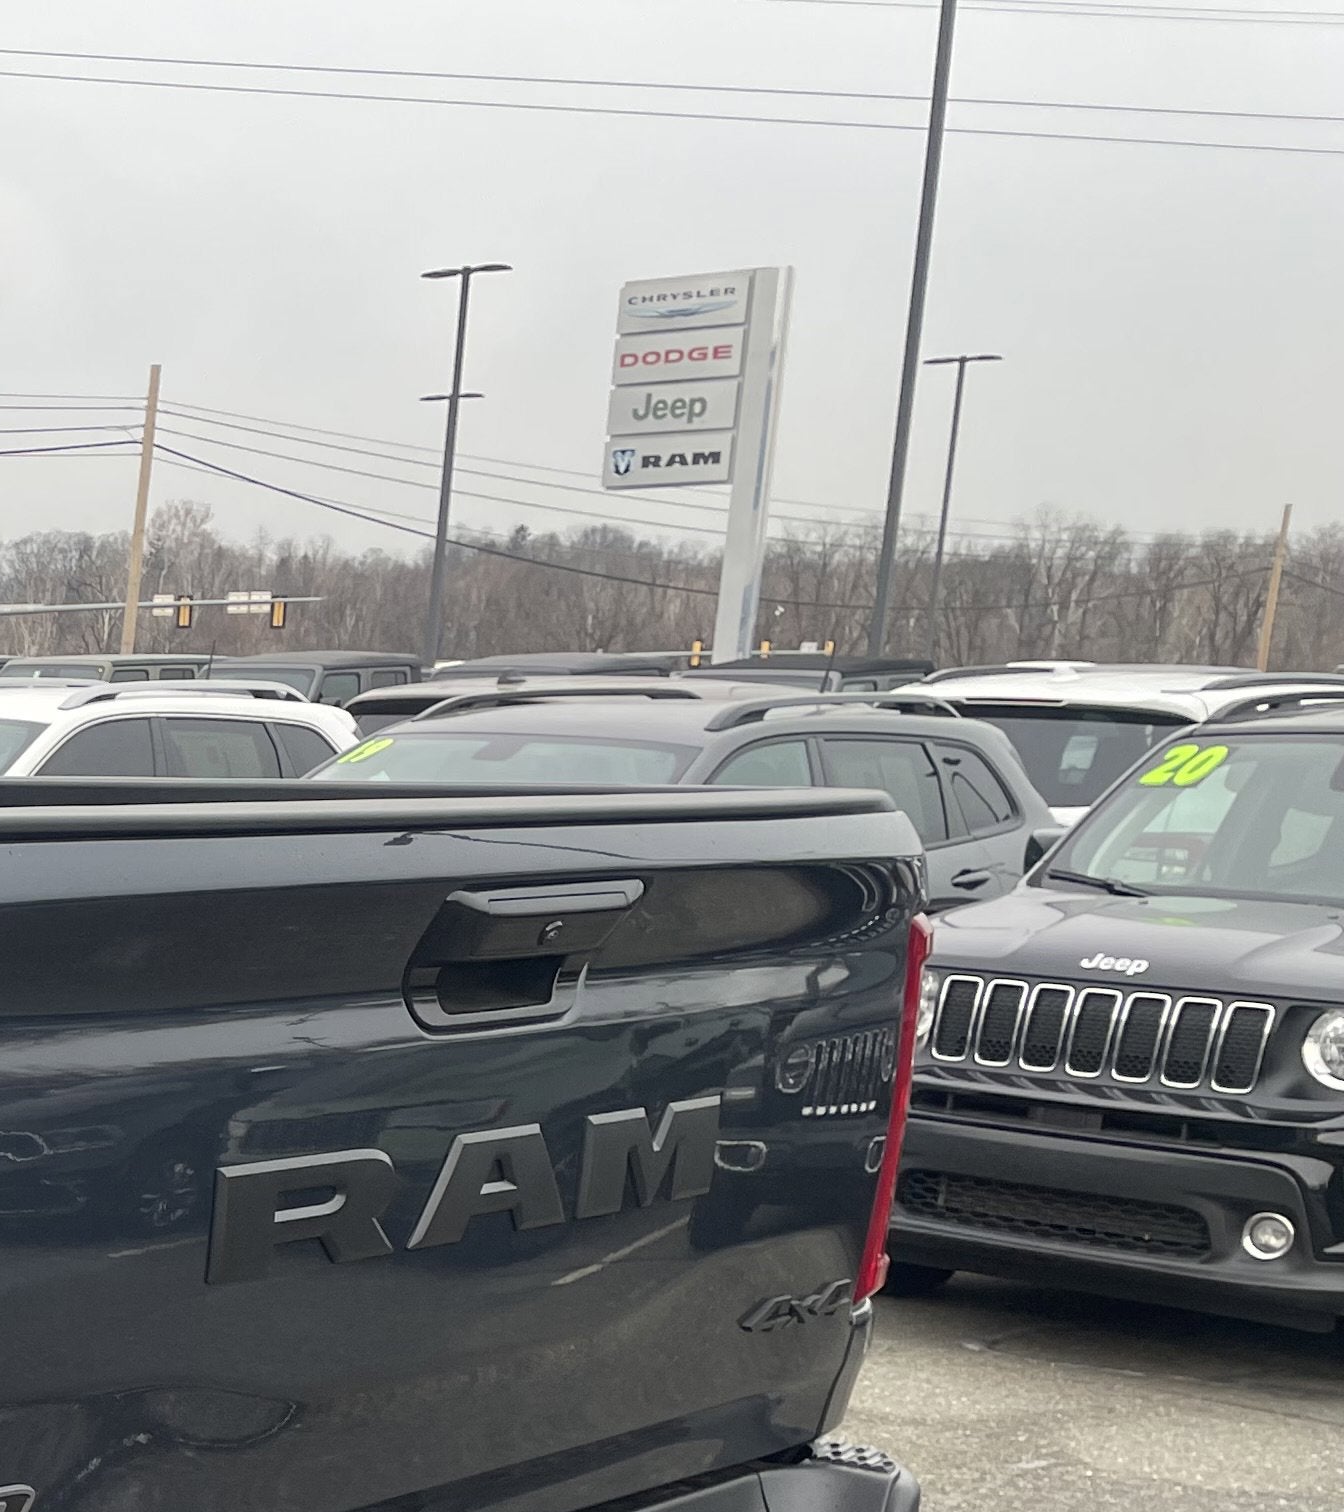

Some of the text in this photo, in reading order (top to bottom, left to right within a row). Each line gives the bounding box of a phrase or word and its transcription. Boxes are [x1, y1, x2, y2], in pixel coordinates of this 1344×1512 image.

[627, 286, 737, 306] CHRYSLER
[619, 344, 733, 368] DODGE
[631, 392, 708, 424] Jeep
[640, 450, 722, 469] RAM
[1138, 743, 1230, 787] 20
[1079, 952, 1150, 976] Jeep
[204, 1093, 723, 1286] RAM
